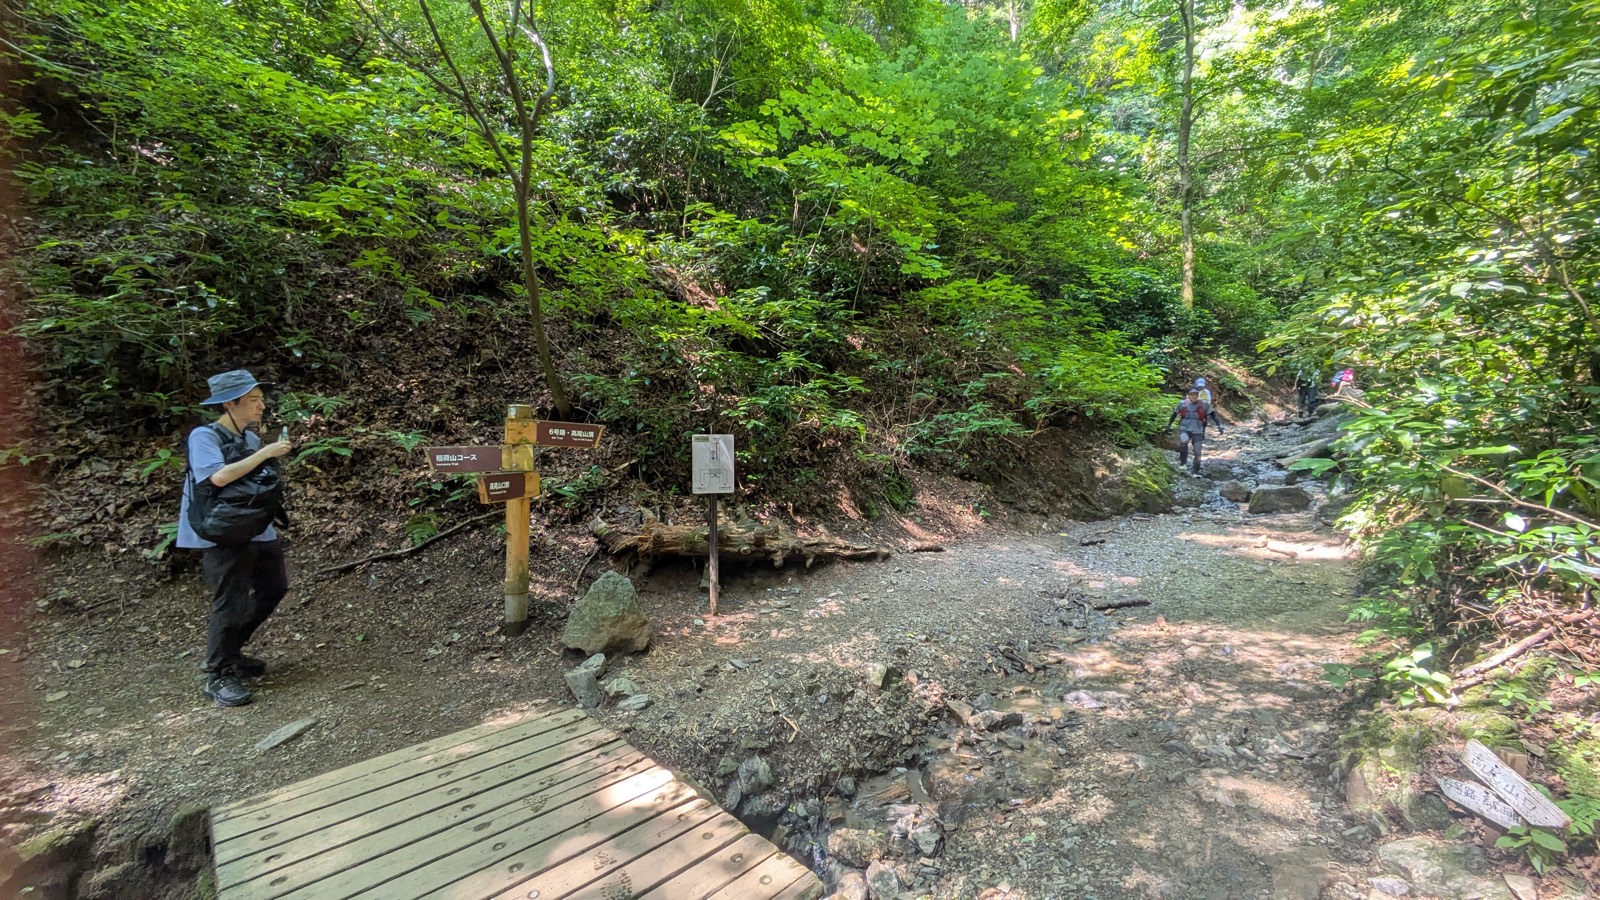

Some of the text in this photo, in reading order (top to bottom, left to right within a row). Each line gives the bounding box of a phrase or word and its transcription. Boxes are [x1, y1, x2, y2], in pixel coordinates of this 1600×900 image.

[436, 454, 477, 462] 稲荷山コース
